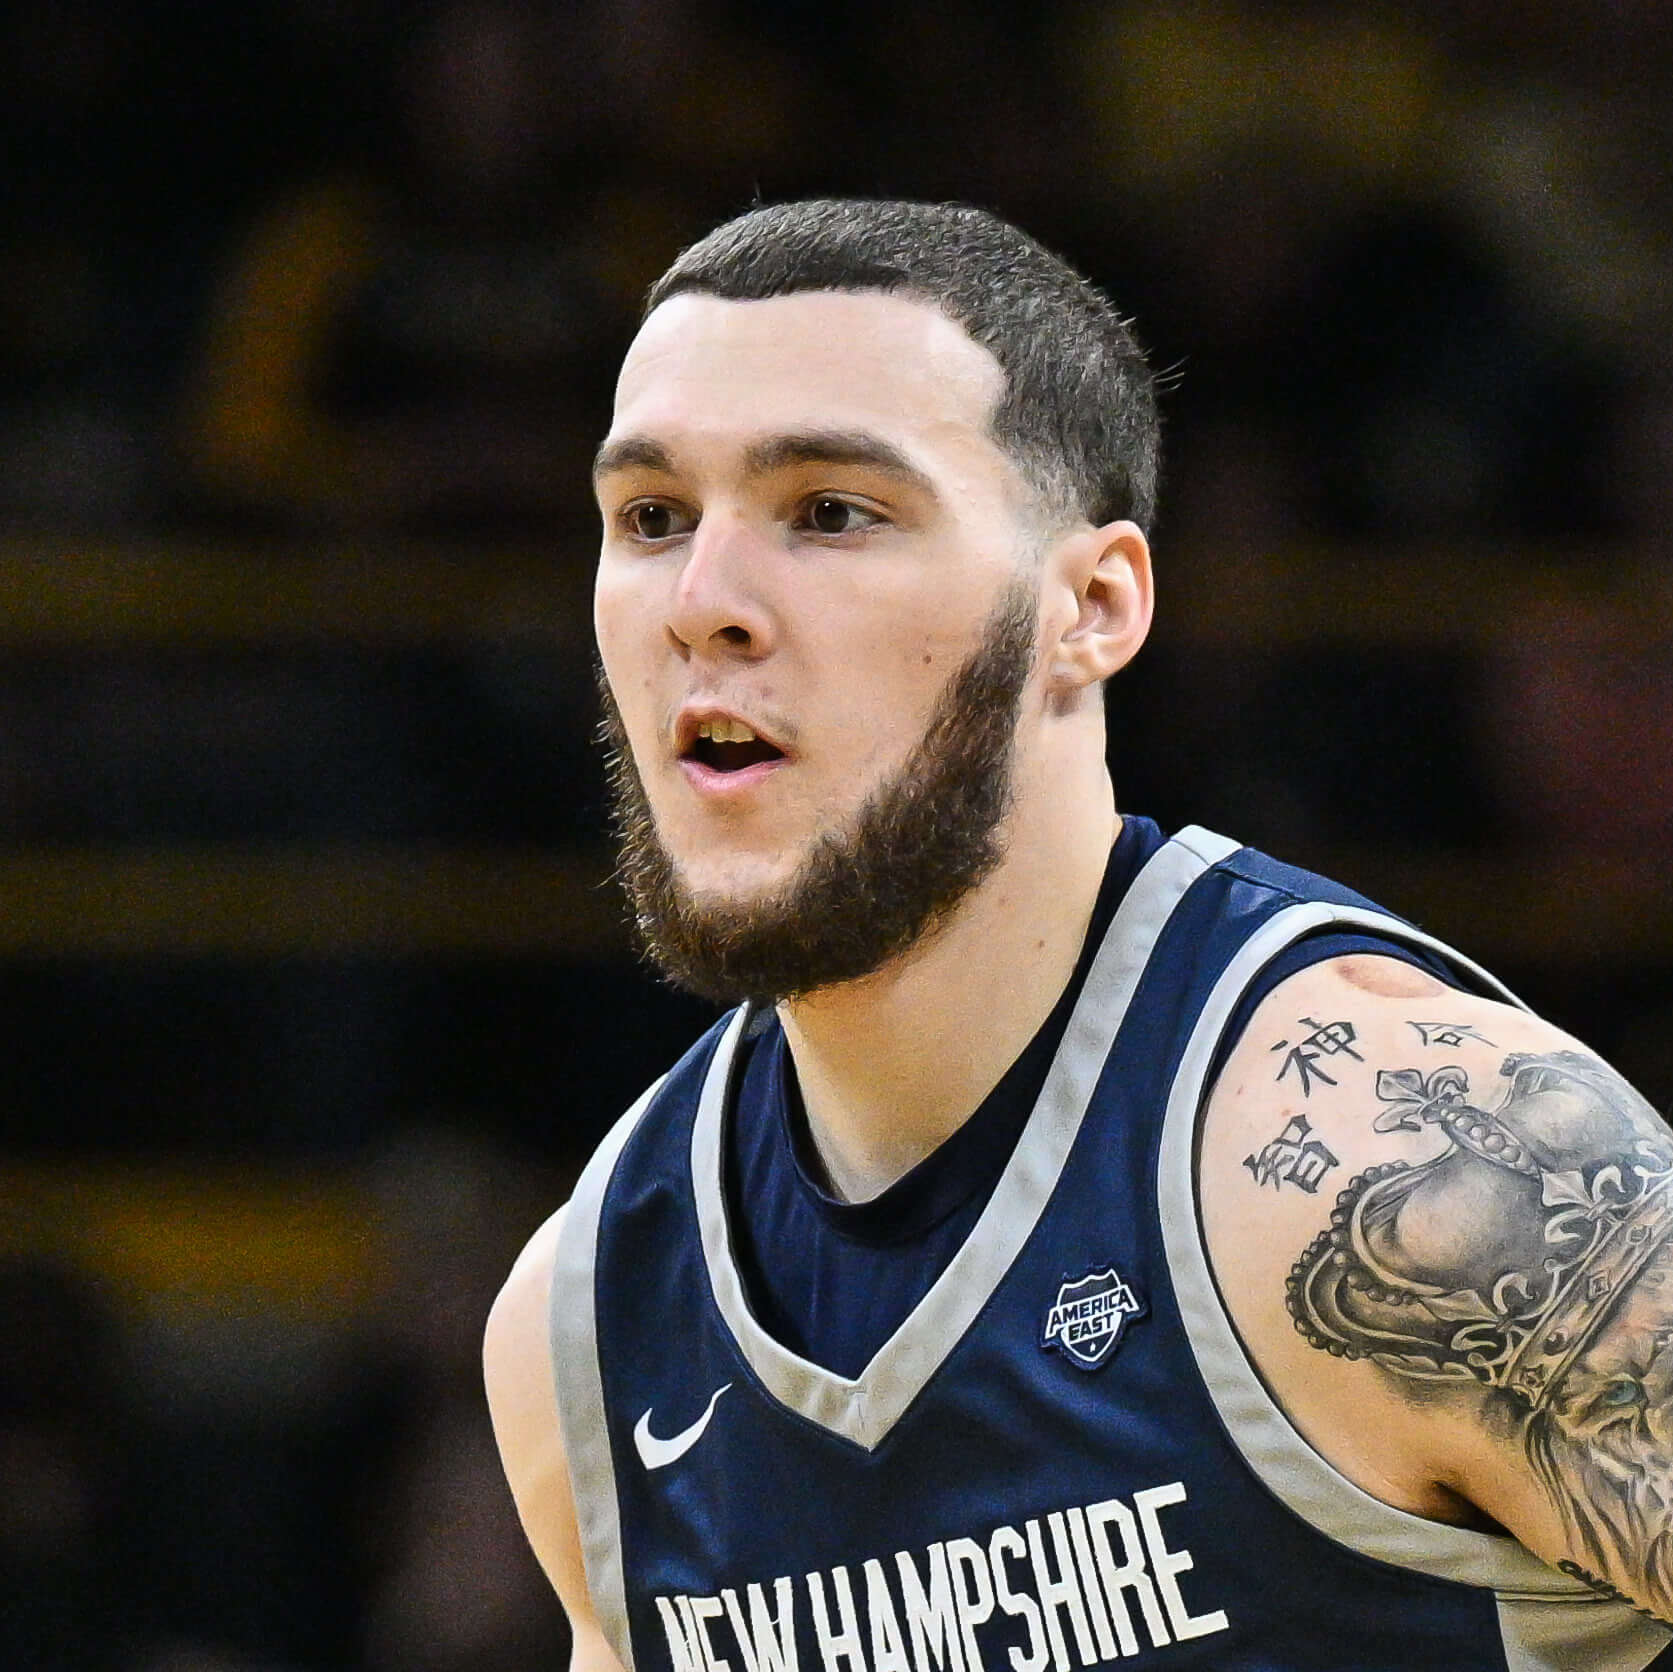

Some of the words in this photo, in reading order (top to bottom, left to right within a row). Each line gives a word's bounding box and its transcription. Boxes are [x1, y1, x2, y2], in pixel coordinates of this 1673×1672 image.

[1270, 1017, 1365, 1098] 神
[1049, 1286, 1133, 1337] AMERICA
[1068, 1312, 1115, 1340] EAST
